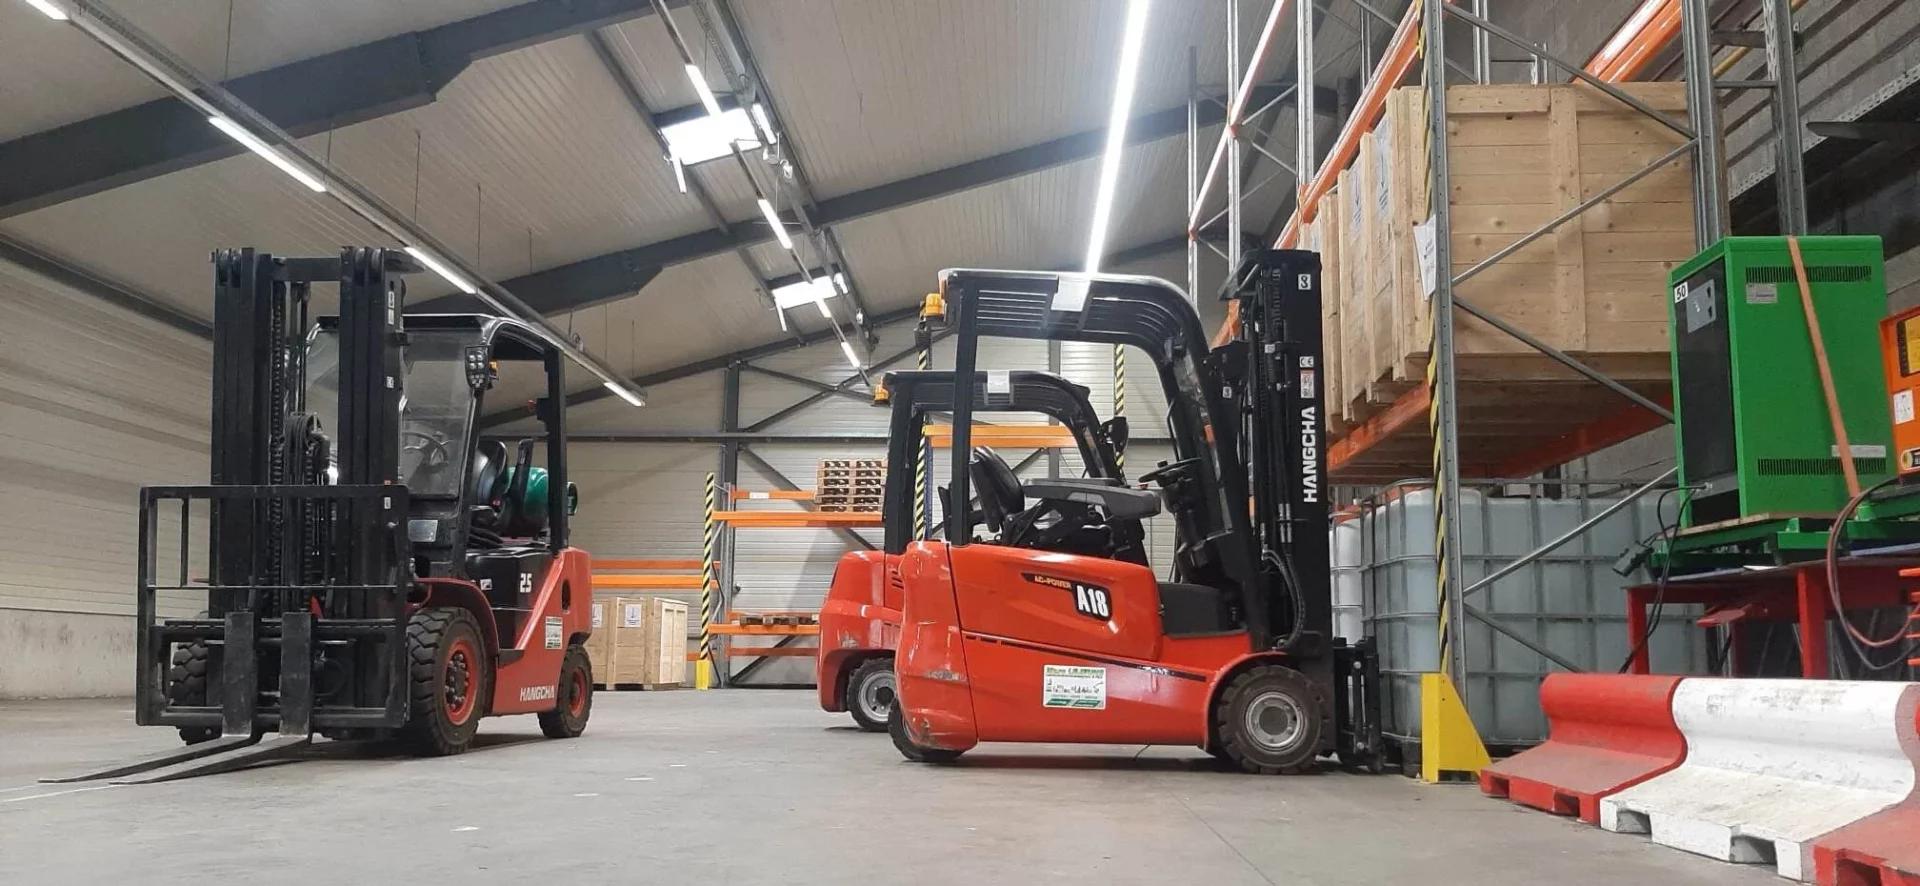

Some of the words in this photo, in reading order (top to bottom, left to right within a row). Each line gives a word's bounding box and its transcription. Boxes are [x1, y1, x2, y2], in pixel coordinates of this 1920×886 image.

[1676, 285, 1686, 301] 50
[1301, 406, 1317, 503] HANGCHA
[520, 573, 532, 593] 25
[1076, 585, 1109, 617] A18
[520, 685, 555, 701] HANGCHA
